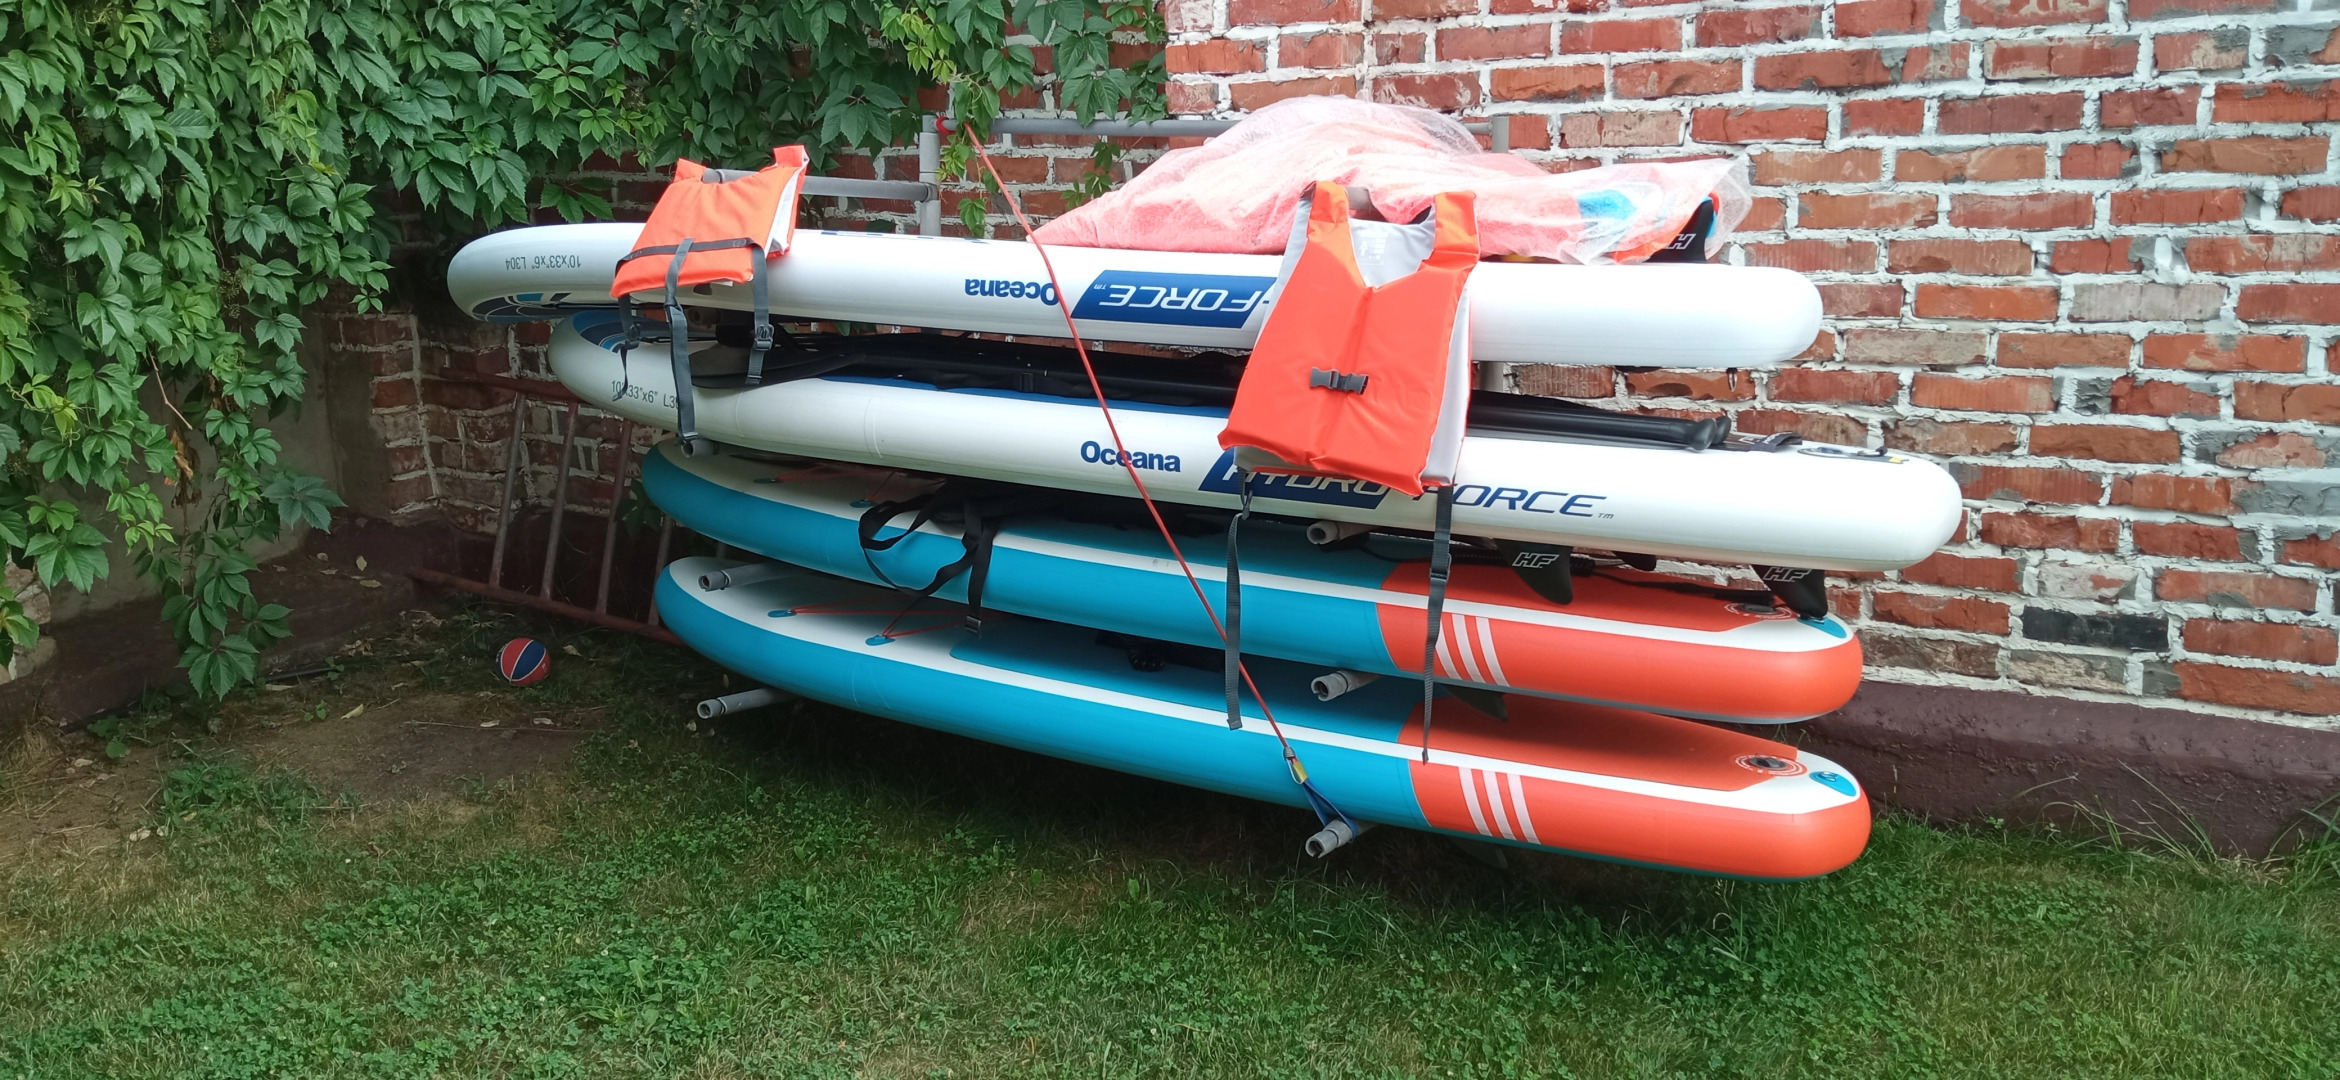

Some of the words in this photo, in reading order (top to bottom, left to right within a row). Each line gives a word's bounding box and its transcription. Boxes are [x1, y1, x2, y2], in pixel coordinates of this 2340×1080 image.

[505, 256, 527, 270] L304
[965, 279, 1060, 306] Oceana
[1080, 441, 1181, 472] Oceana
[1598, 512, 1614, 520] TM
[1512, 552, 1559, 568] HF
[1763, 566, 1812, 582] HF
